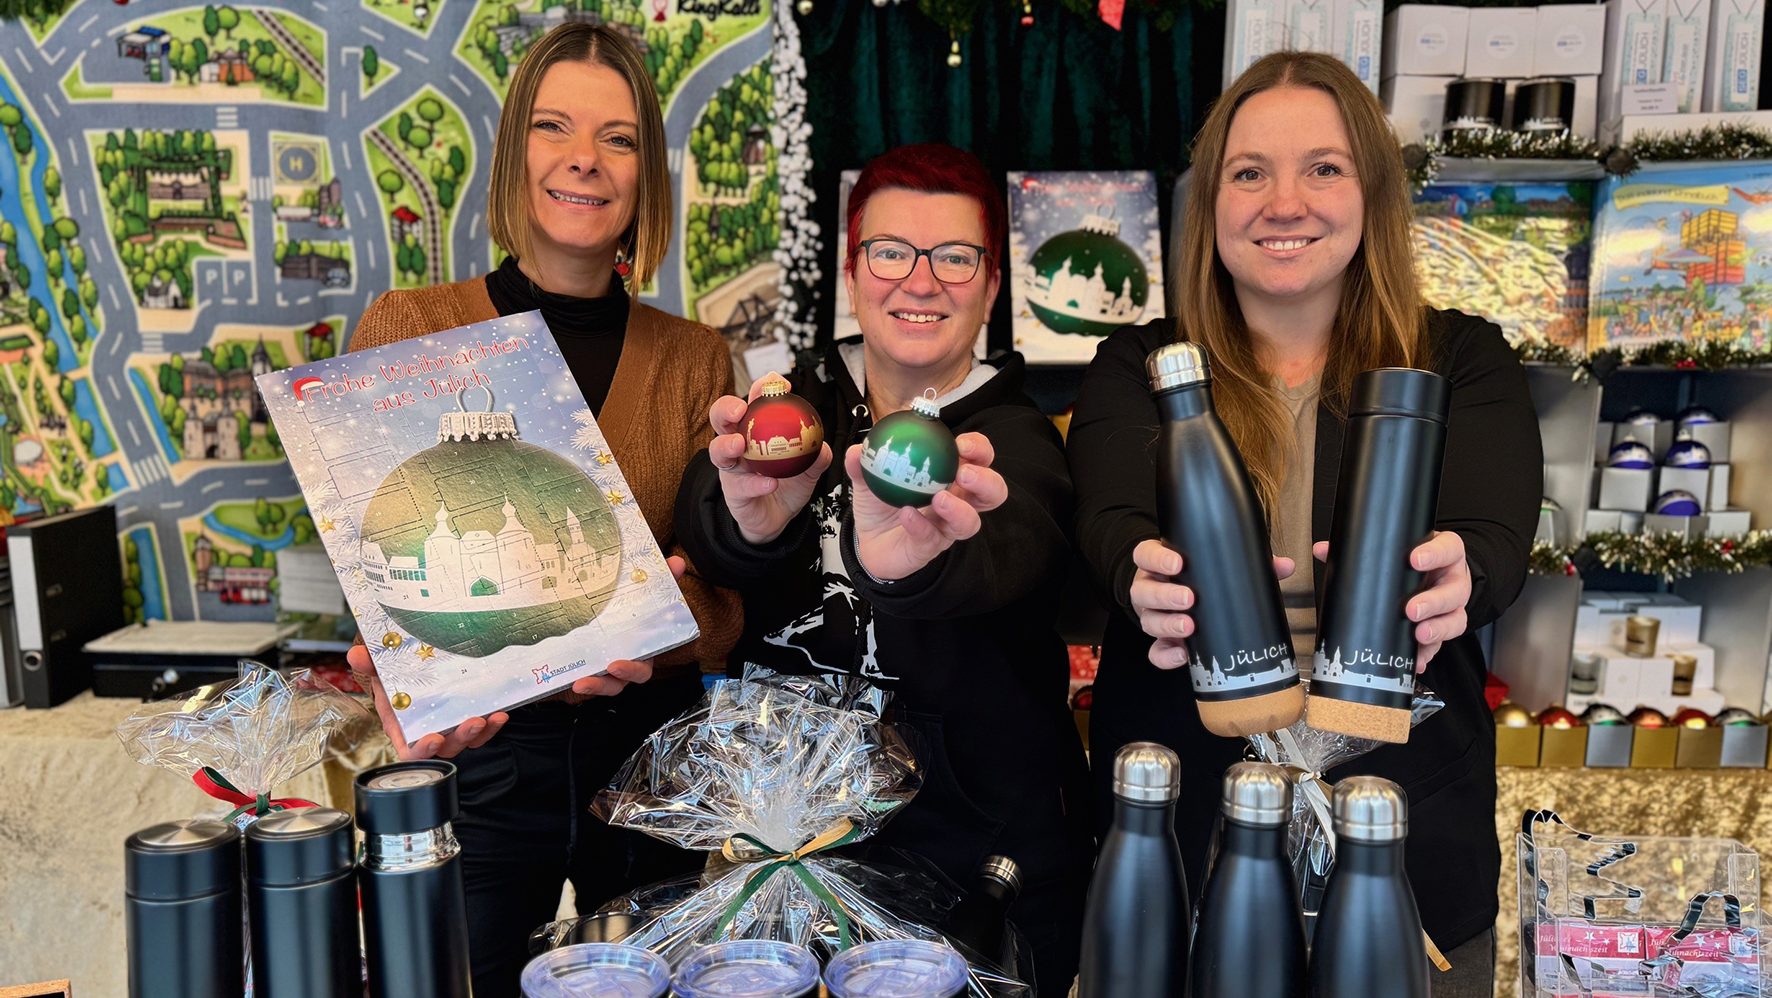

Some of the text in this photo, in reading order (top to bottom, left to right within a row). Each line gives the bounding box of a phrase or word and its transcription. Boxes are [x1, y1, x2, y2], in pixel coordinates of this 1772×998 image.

[205, 269, 245, 285] P P
[303, 336, 530, 402] Frohe Weihnachten
[373, 368, 492, 413] aus Jülich
[550, 659, 587, 676] STADT JÜLICH
[1224, 642, 1288, 672] JÜLICH
[1344, 648, 1414, 671] JÜLICH
